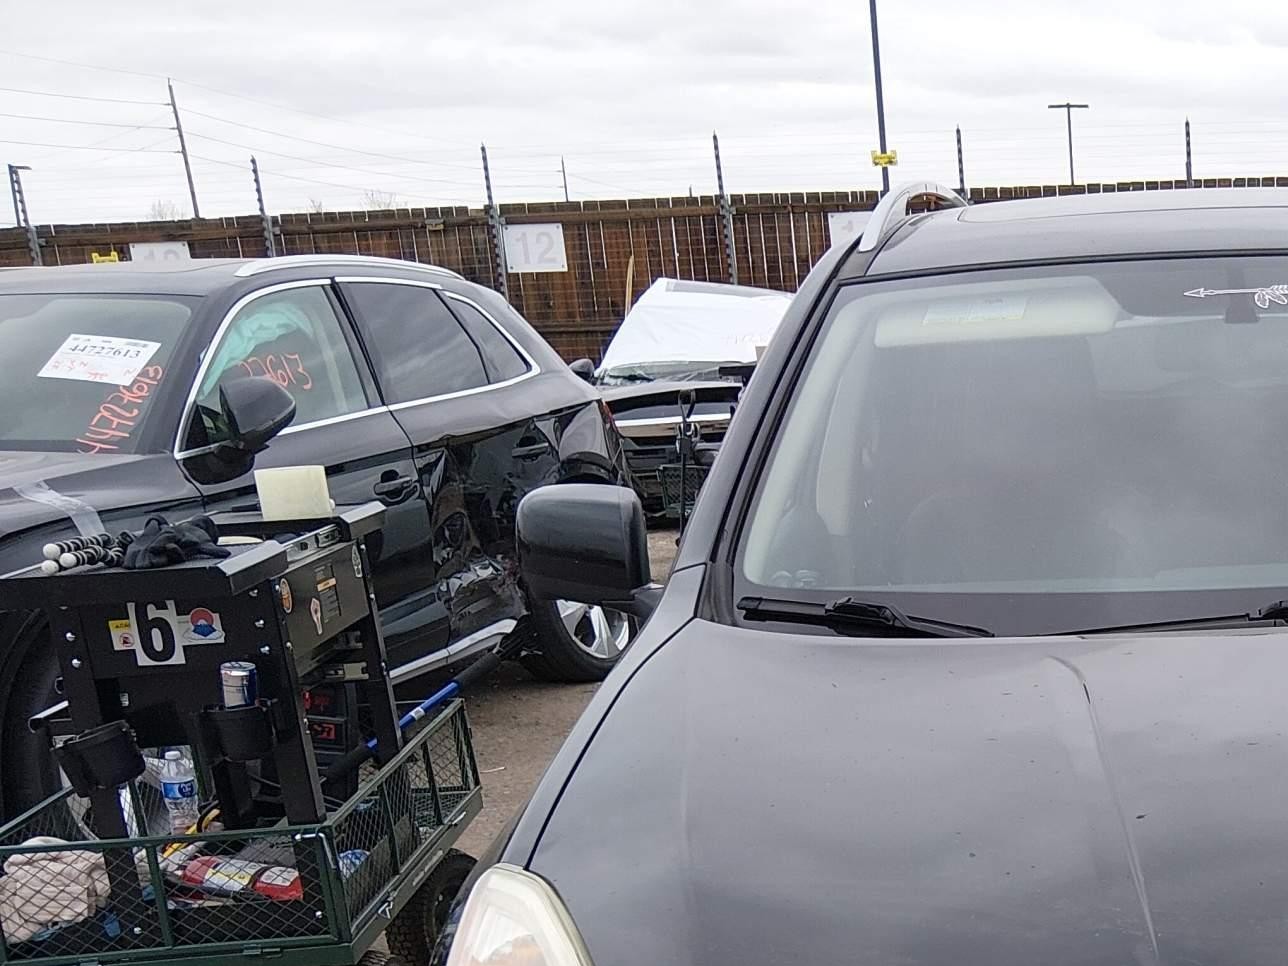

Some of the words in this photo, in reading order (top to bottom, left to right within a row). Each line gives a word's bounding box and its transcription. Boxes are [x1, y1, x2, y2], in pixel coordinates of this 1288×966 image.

[514, 231, 557, 265] 12
[68, 344, 141, 358] 44727613
[134, 598, 176, 662] 6
